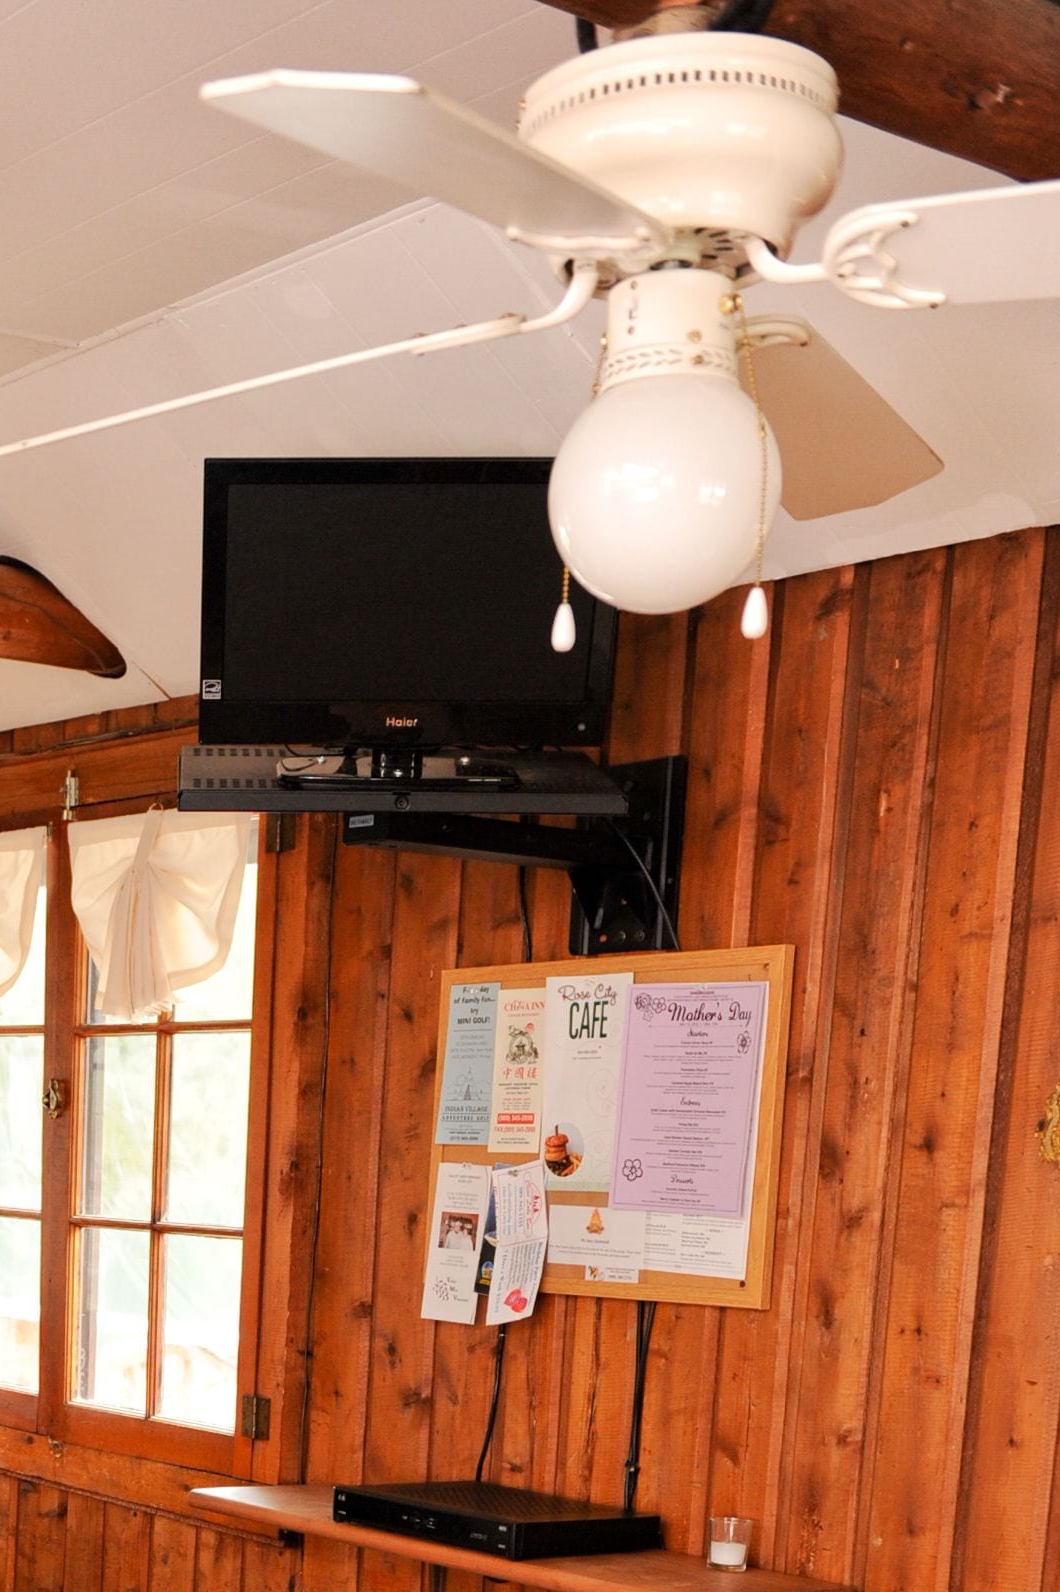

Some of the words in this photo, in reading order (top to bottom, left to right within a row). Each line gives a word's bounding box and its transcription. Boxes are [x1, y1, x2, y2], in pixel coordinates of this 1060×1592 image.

[386, 717, 418, 728] Haier
[461, 996, 480, 1005] family
[557, 984, 592, 1001] Rose
[593, 983, 617, 1006] City
[457, 1017, 471, 1025] MINI
[568, 1000, 609, 1040] CAFE
[667, 1001, 723, 1022] Mother's
[728, 1001, 752, 1027] Day
